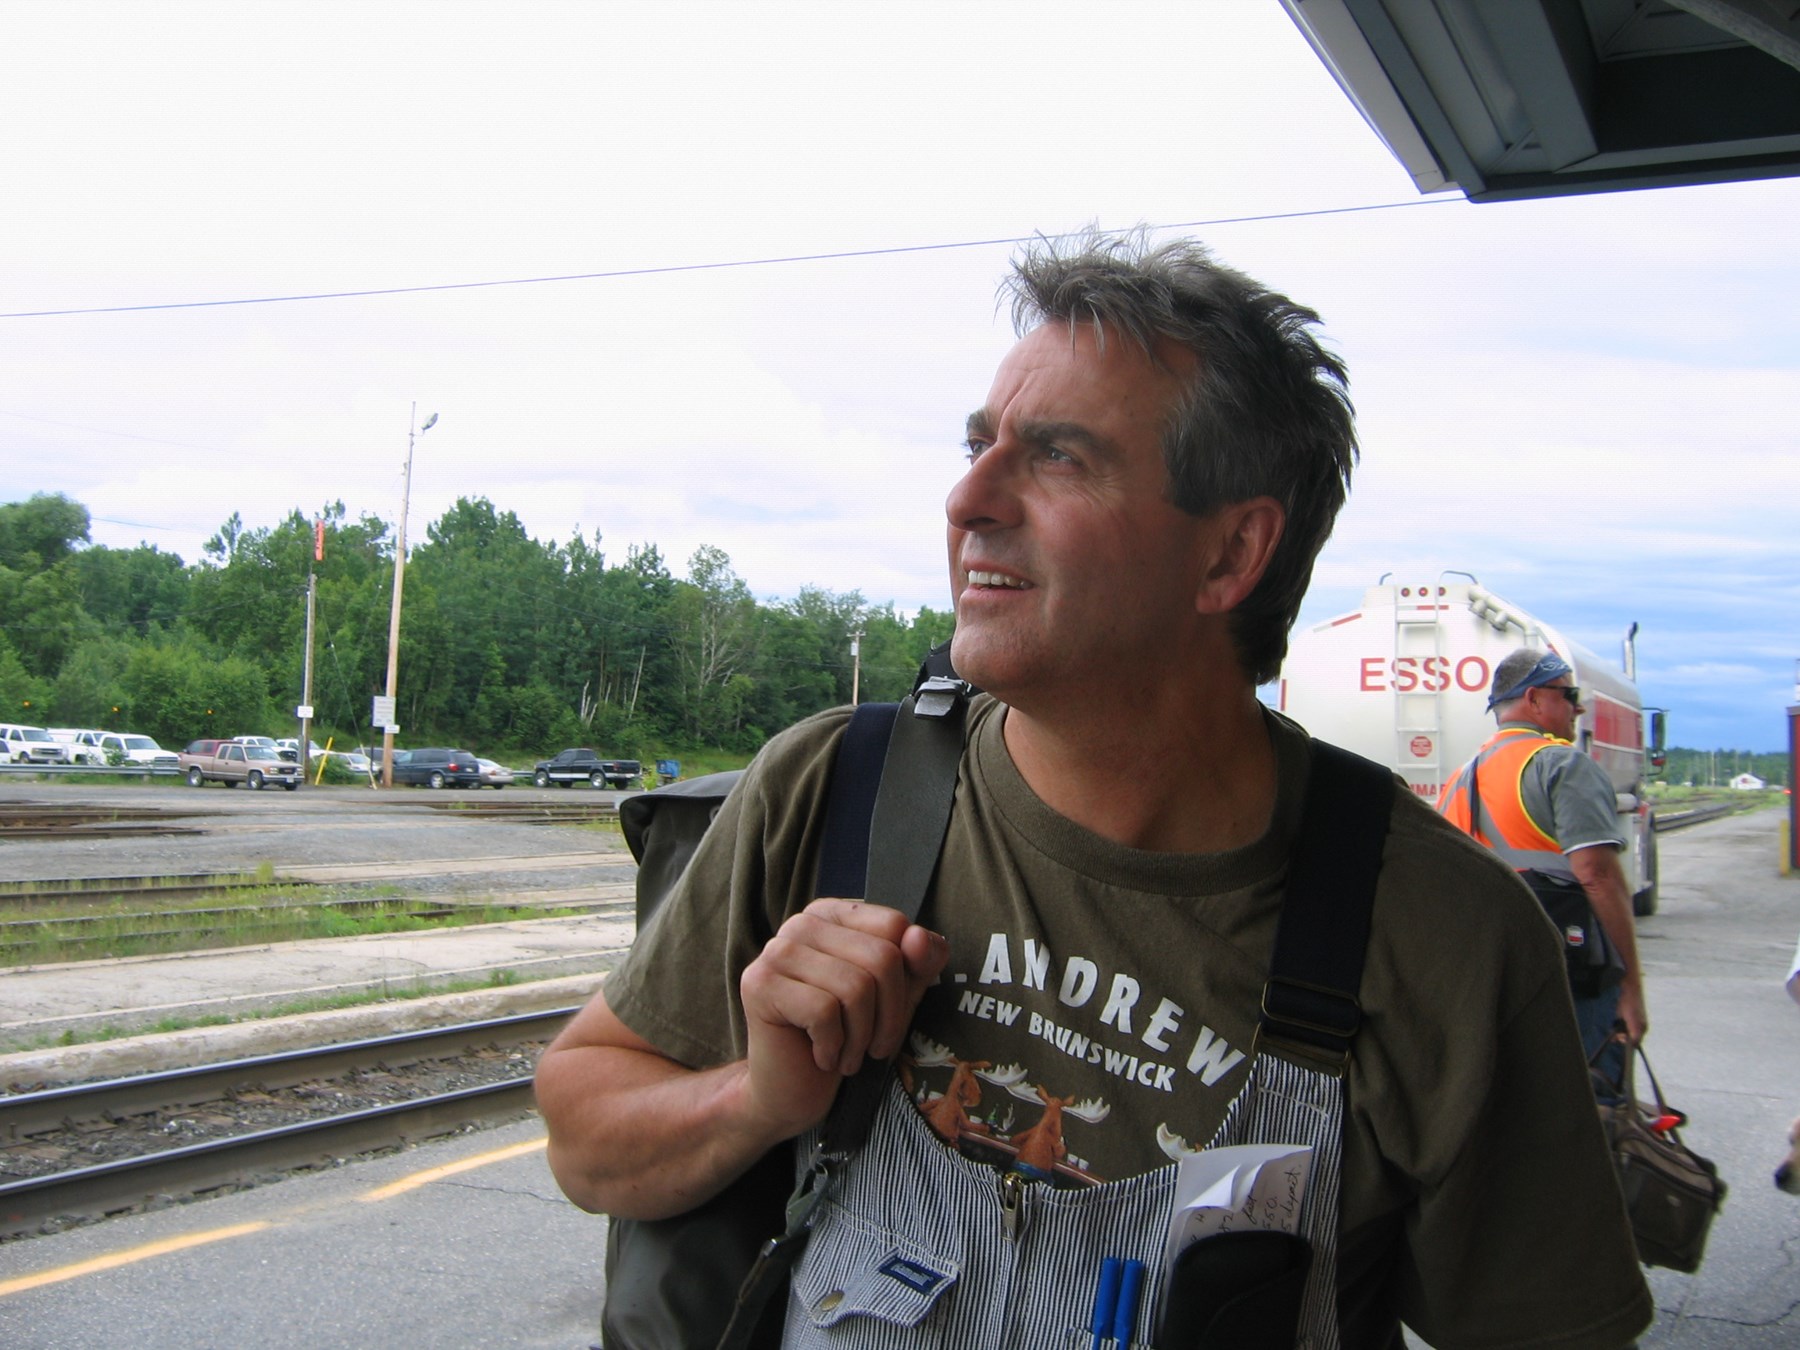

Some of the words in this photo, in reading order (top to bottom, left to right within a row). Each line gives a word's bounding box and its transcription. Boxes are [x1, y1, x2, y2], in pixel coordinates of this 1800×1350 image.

[1360, 656, 1490, 692] ESSO
[958, 990, 1022, 1027] NEW
[1028, 1012, 1176, 1092] BRUNSWICK
[979, 933, 1246, 1087] ANDREW
